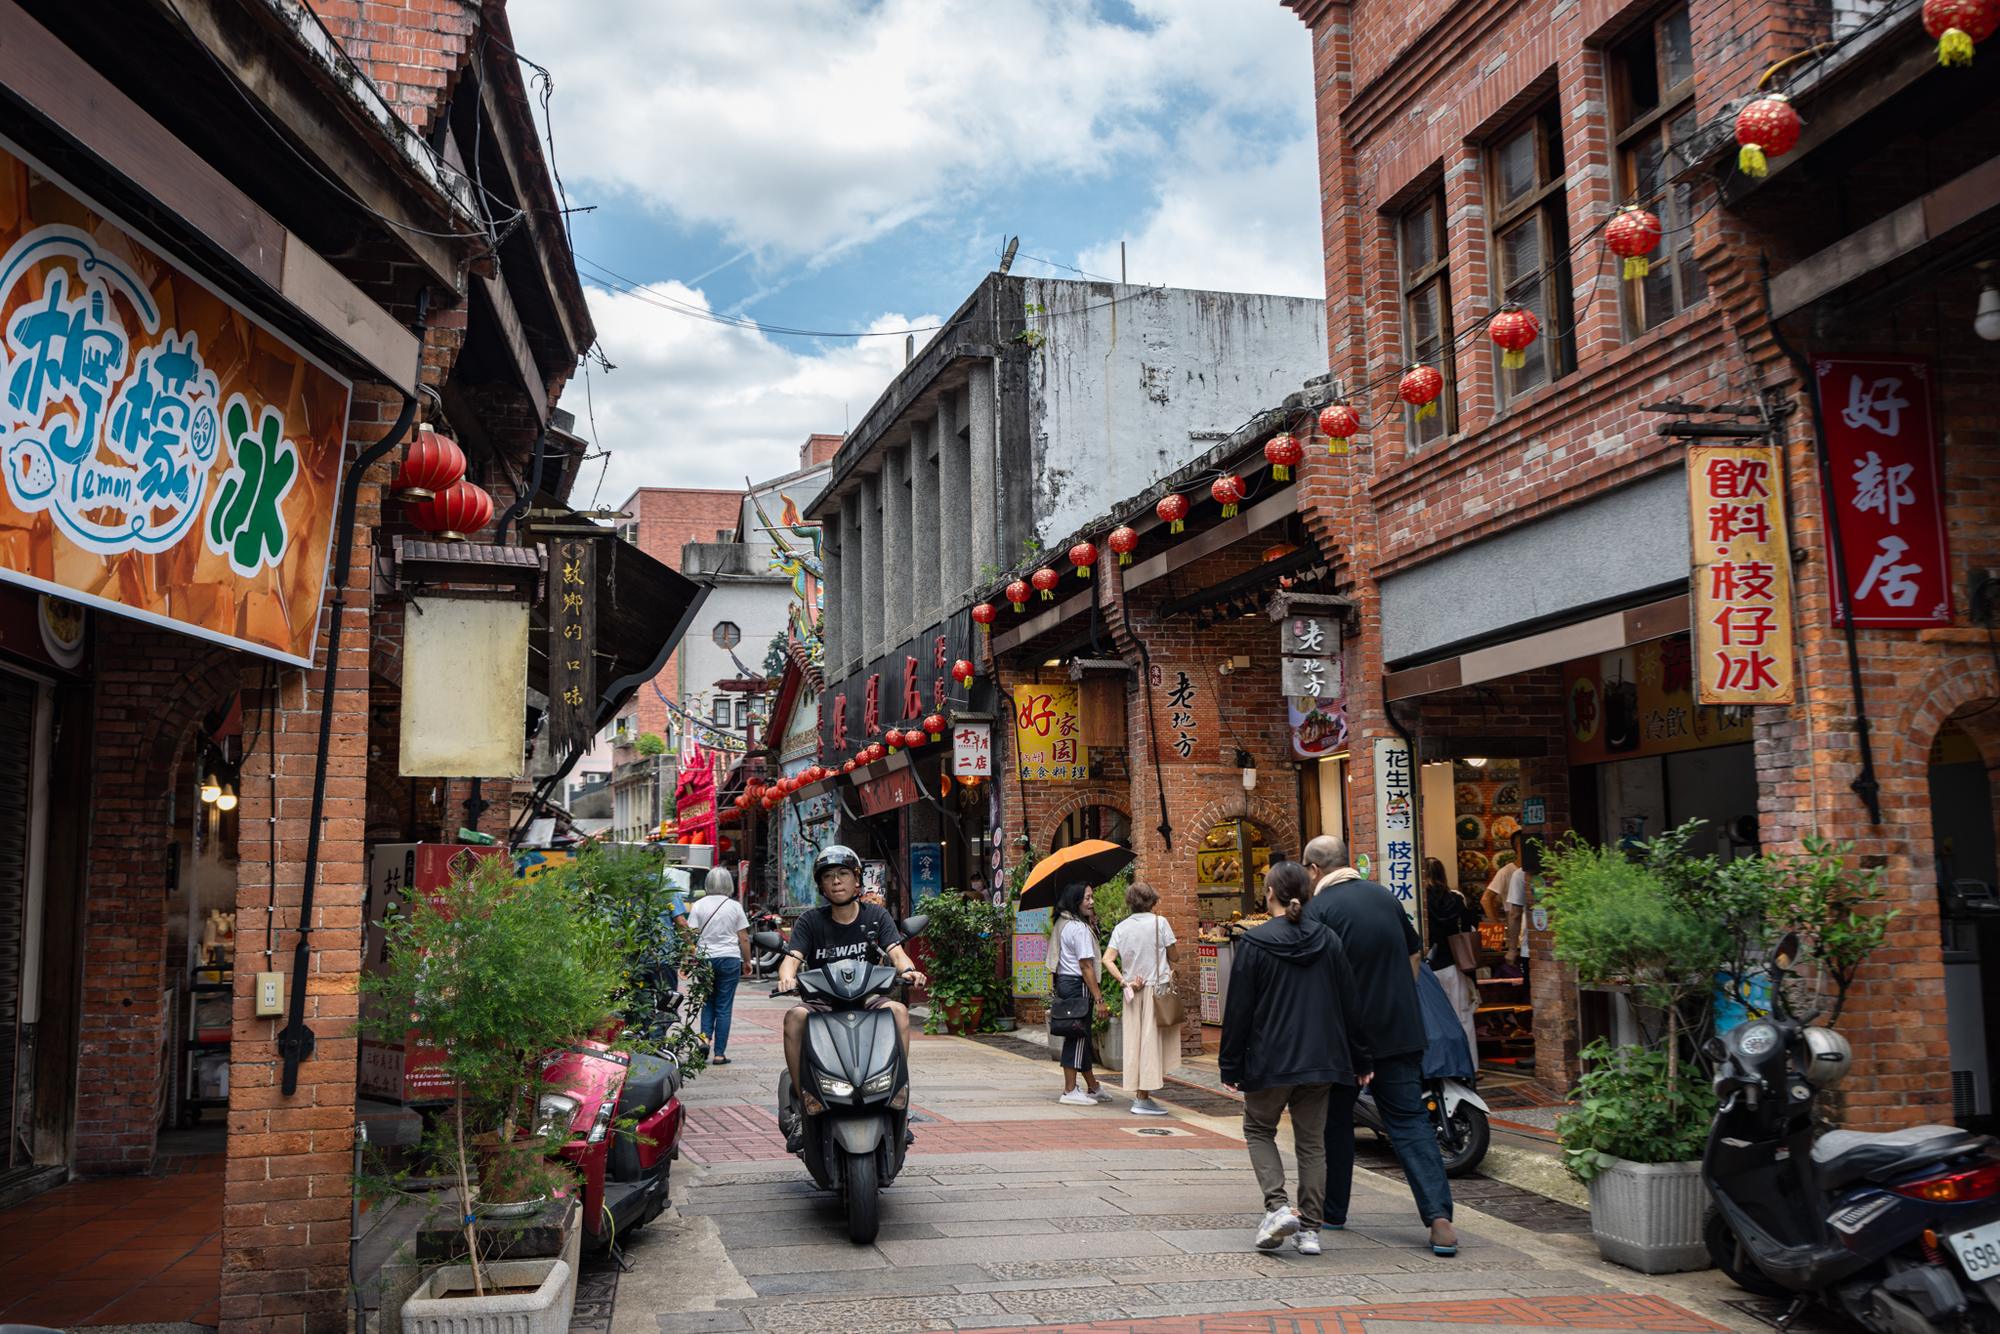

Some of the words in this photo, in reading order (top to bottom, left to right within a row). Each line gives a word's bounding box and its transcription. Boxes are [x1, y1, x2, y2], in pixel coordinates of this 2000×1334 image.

[211, 402, 294, 568] 冰
[1840, 373, 1923, 608] 好鄰居
[562, 560, 584, 705] 故鄉的口味
[1299, 619, 1326, 697] 老地方
[1167, 671, 1199, 758] 老地方
[1387, 841, 1414, 900] 枝仔冰
[1963, 1242, 2000, 1272] 698
